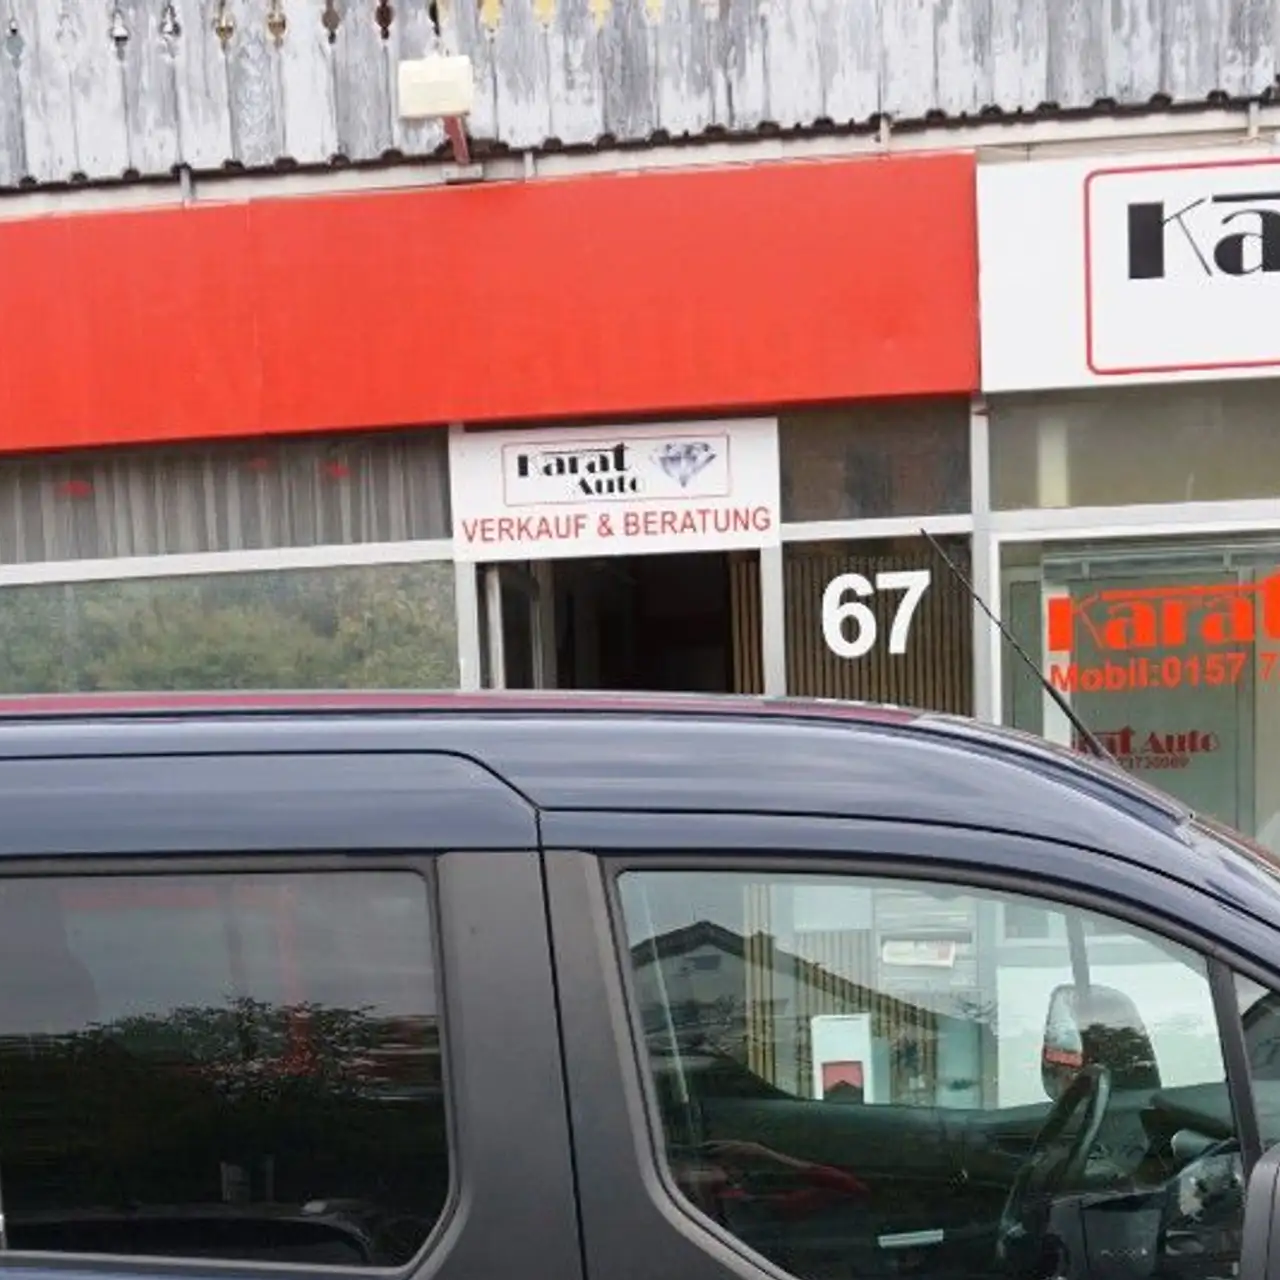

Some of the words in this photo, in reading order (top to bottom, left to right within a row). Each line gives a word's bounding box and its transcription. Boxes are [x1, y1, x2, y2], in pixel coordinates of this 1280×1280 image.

[516, 443, 632, 479] Karat
[576, 473, 645, 496] Auto
[462, 515, 588, 543] VERKAUF
[596, 513, 615, 539] &
[623, 506, 771, 536] BERATUNG
[822, 569, 931, 658] 67
